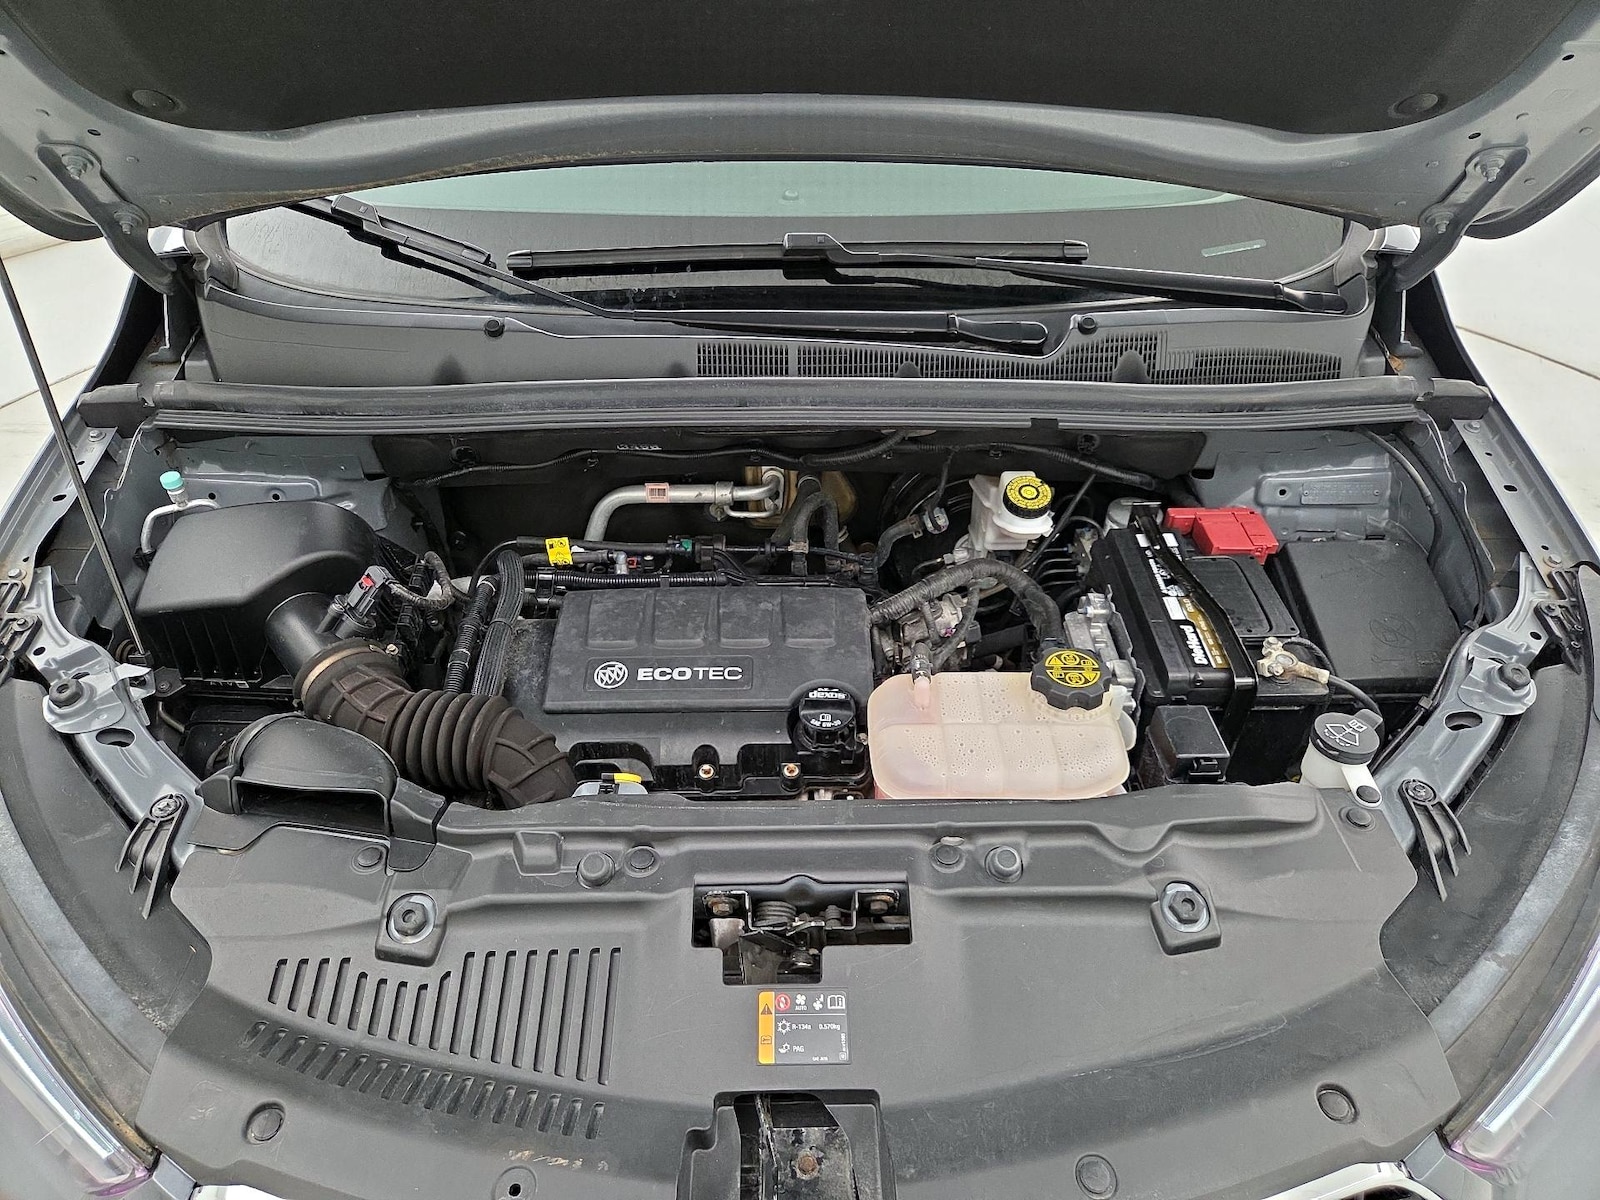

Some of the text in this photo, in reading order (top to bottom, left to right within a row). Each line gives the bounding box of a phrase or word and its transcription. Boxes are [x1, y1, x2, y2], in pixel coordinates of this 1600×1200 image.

[1179, 624, 1209, 665] DieHard
[637, 667, 743, 681] ECOTEC
[809, 690, 846, 699] dexos
[792, 1045, 805, 1053] PAG
